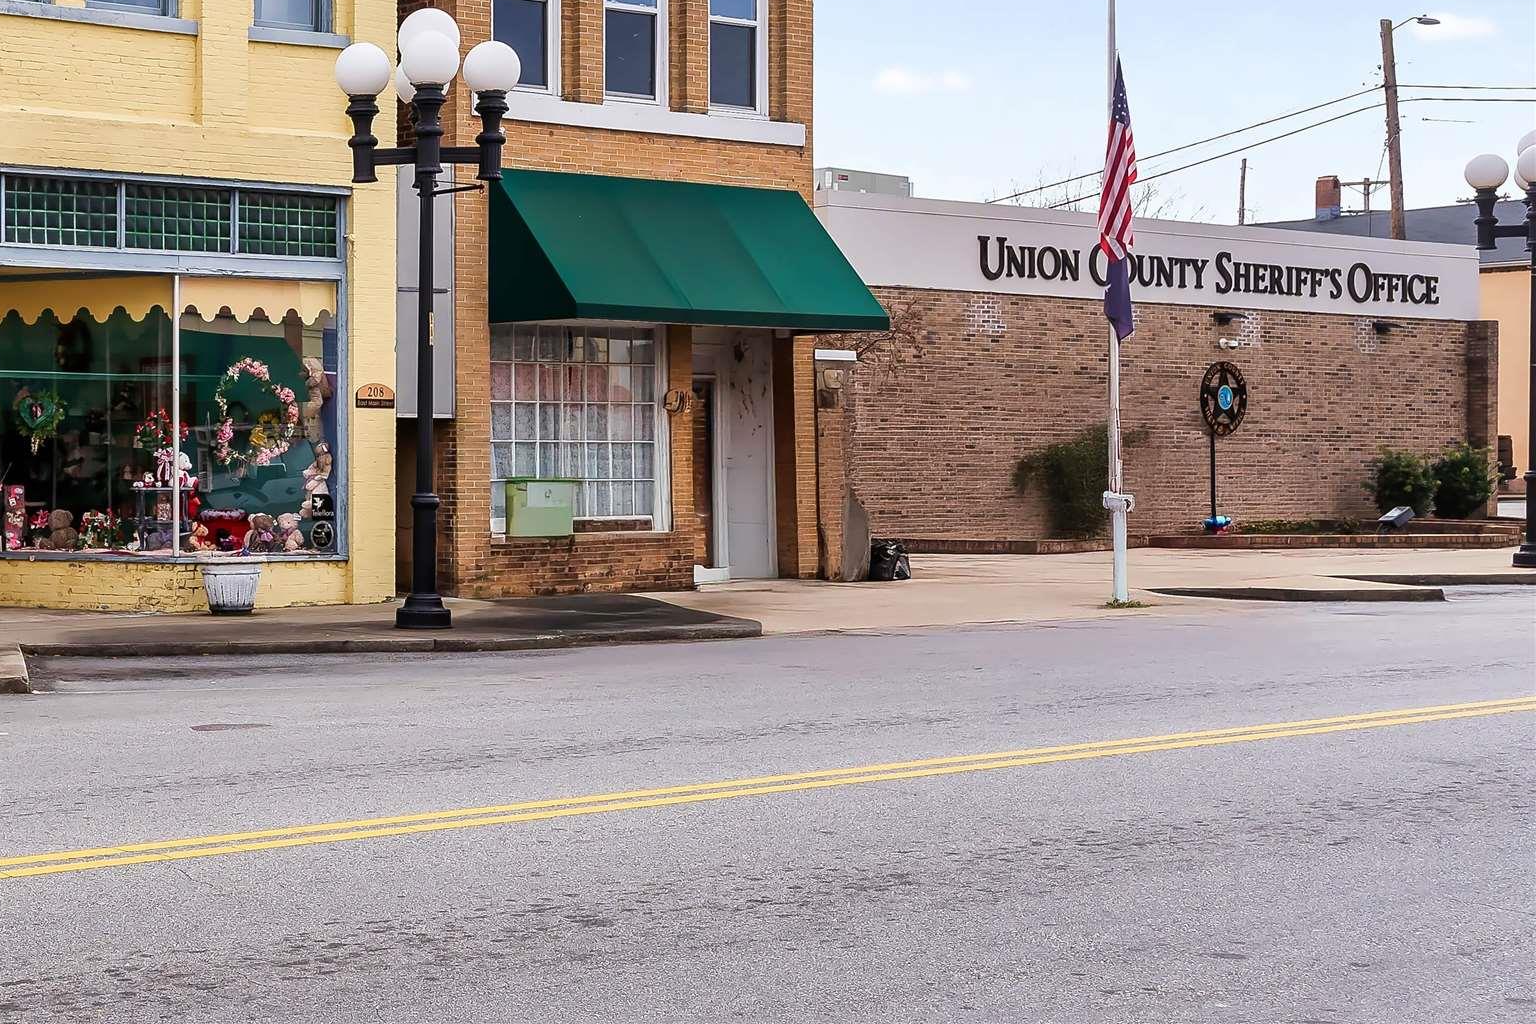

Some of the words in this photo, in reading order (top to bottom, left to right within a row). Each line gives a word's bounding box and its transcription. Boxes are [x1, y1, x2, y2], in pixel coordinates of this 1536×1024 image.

[977, 235, 1080, 281] UNION
[1215, 251, 1342, 299] SHERIFF'S
[1347, 262, 1440, 304] OFFICE
[367, 386, 385, 397] 208
